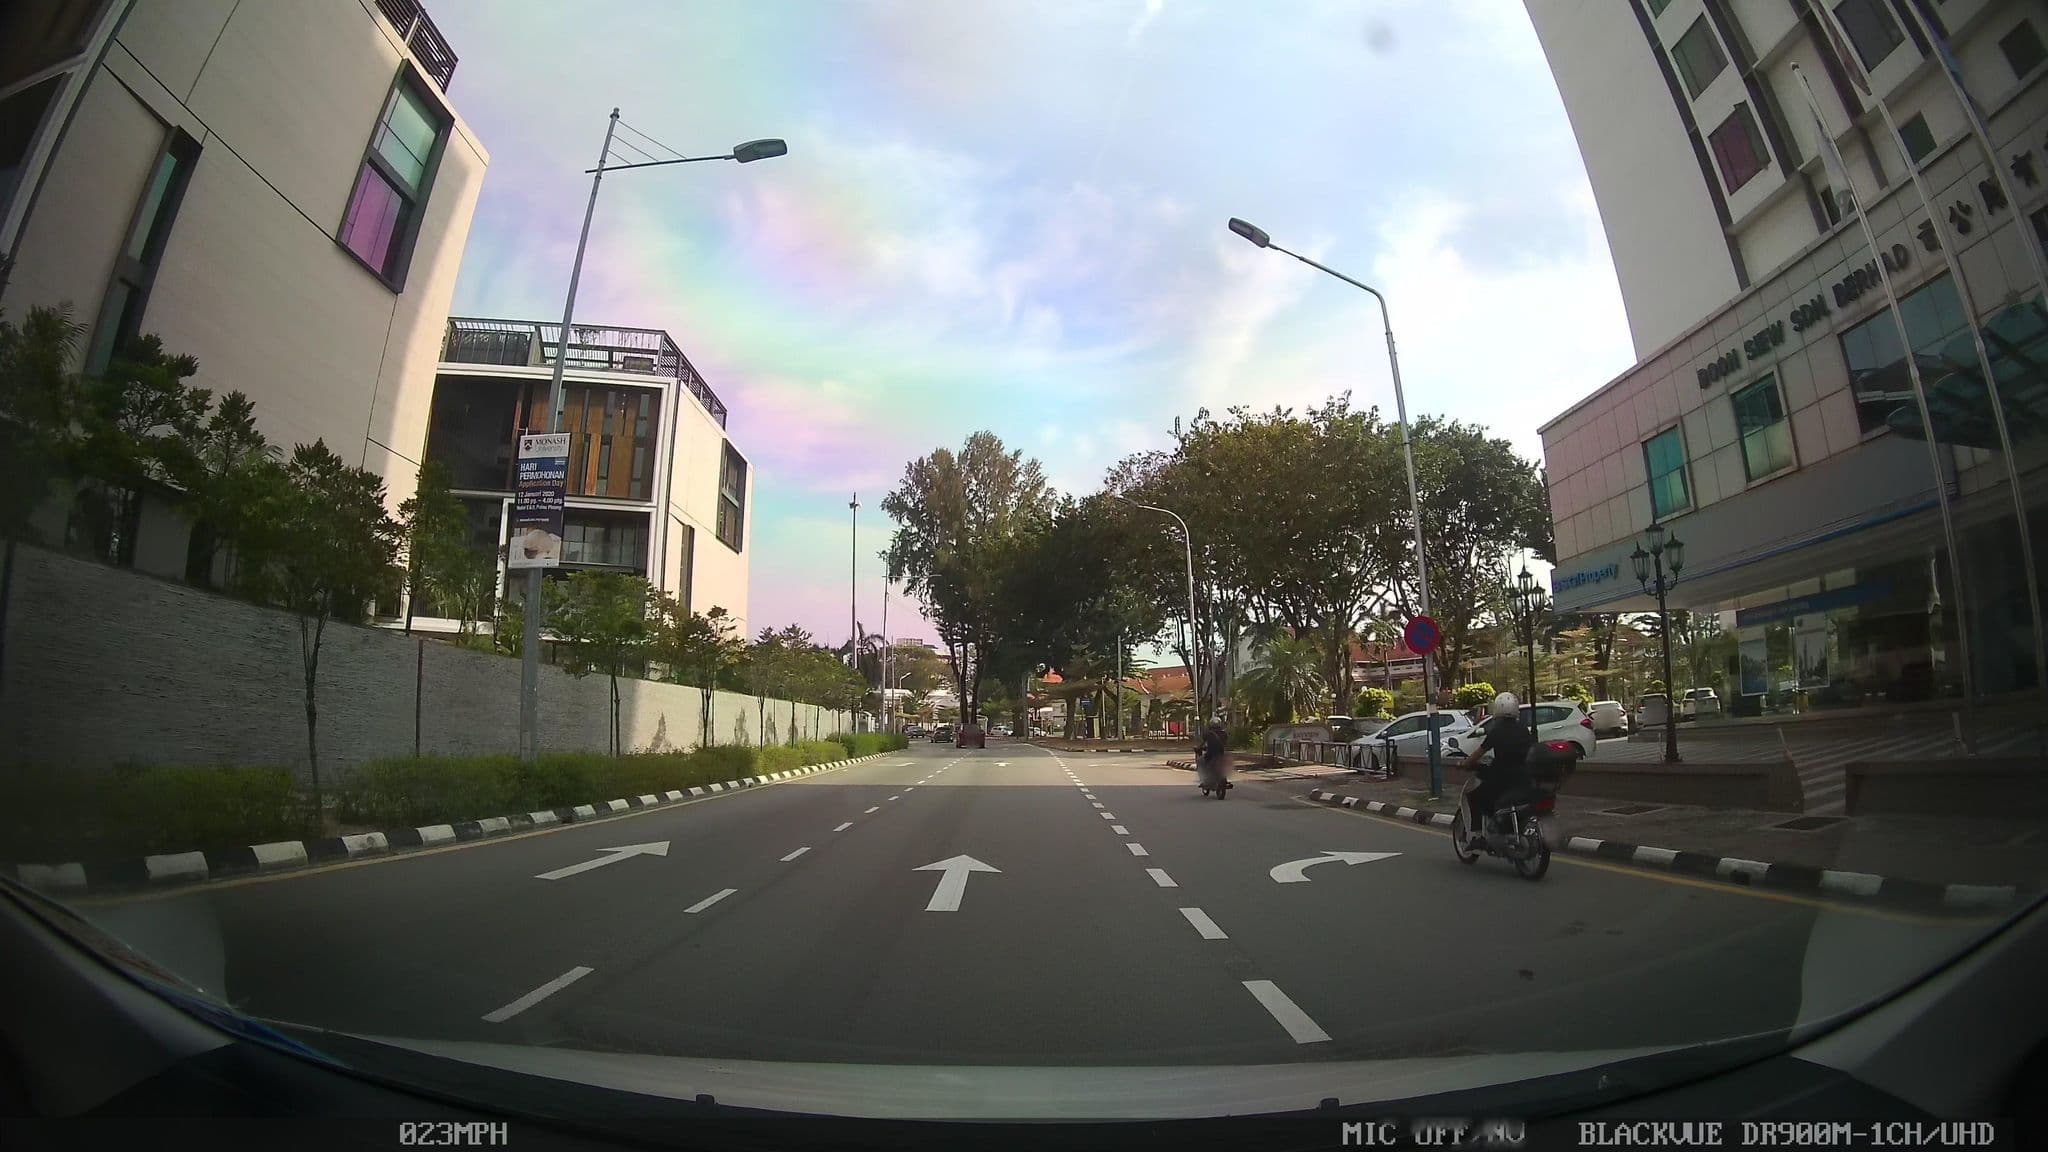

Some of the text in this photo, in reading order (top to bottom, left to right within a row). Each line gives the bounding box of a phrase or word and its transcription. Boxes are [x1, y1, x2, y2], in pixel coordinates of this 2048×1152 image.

[1697, 348, 1742, 389] BOON
[1744, 320, 1785, 360] SIEW
[1832, 244, 1909, 308] BERHAD
[535, 437, 566, 445] MONASH
[520, 463, 537, 471] HARI
[520, 471, 565, 480] PERMOHONAN
[519, 480, 550, 488] Application
